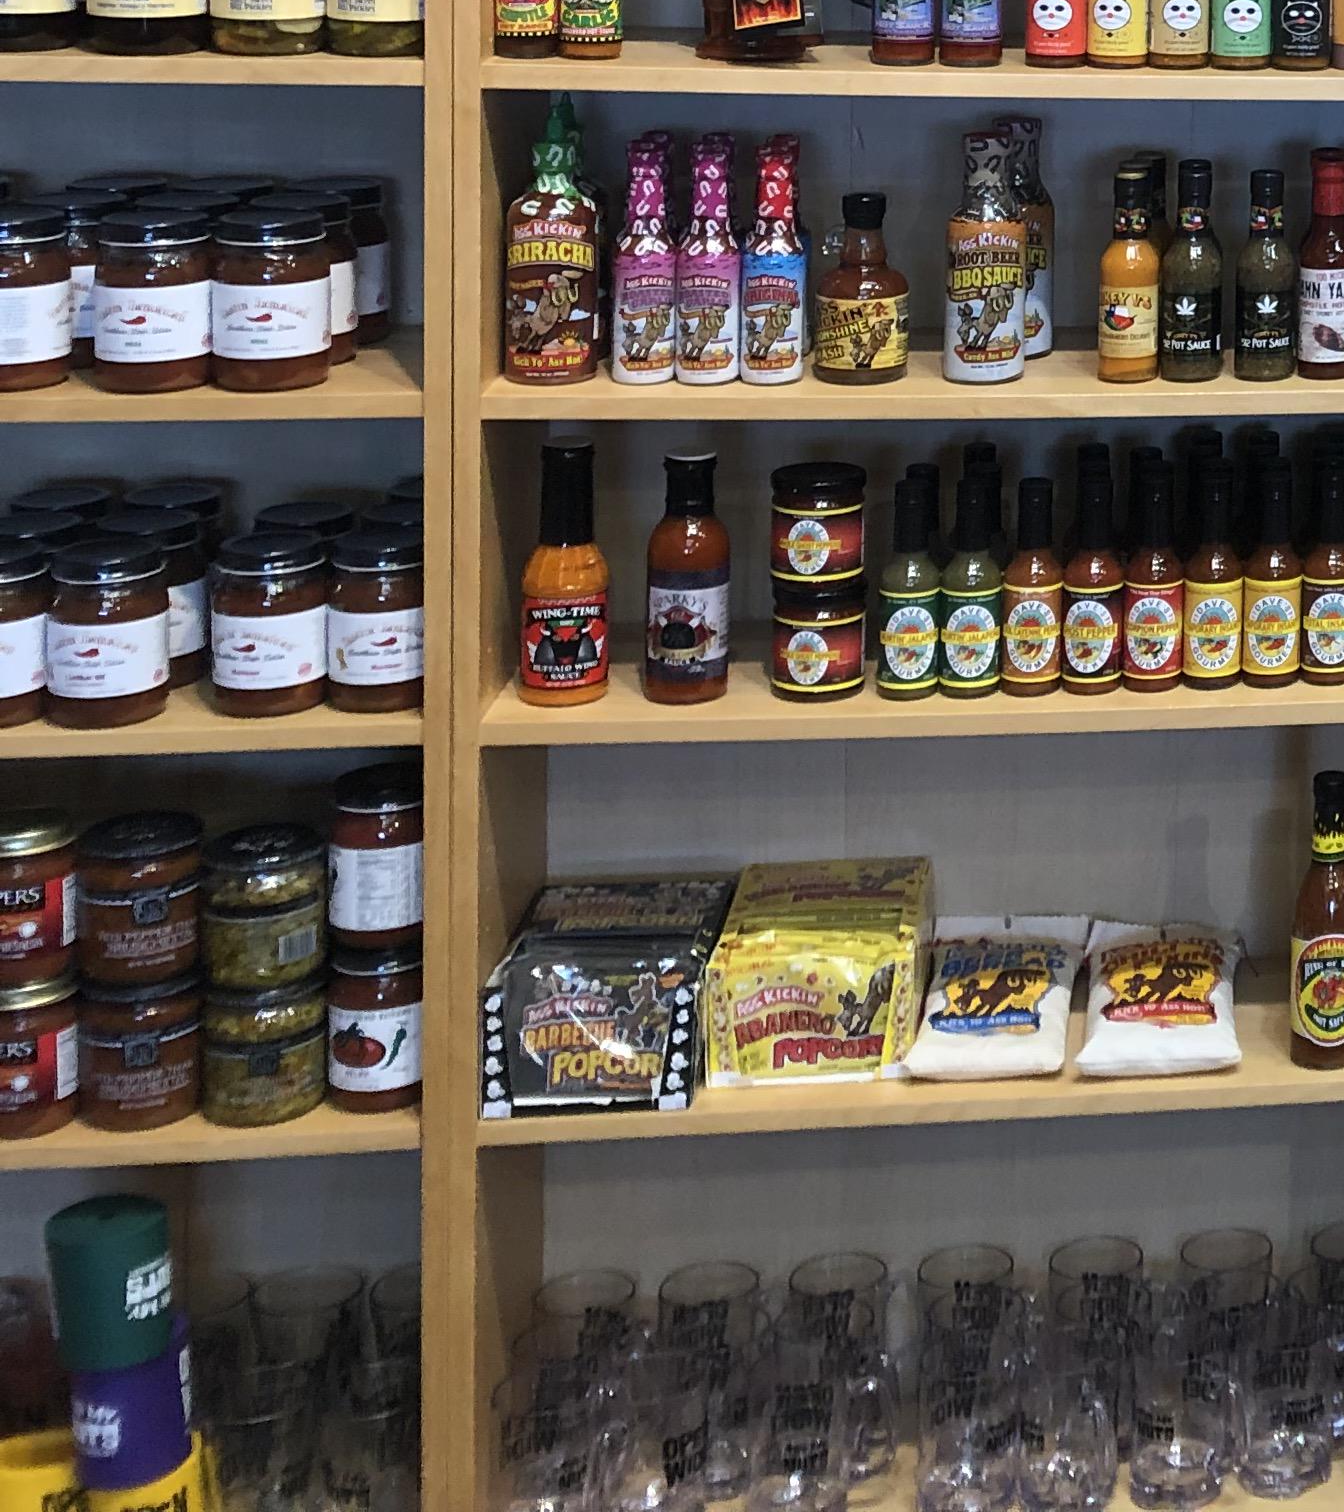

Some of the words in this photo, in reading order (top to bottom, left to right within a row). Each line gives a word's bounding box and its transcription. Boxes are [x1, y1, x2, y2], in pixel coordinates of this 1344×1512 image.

[508, 242, 593, 264] SRIRACHA
[953, 269, 981, 287] BBQ
[982, 266, 1023, 286] SAUCE
[552, 1052, 661, 1082] POPCOR
